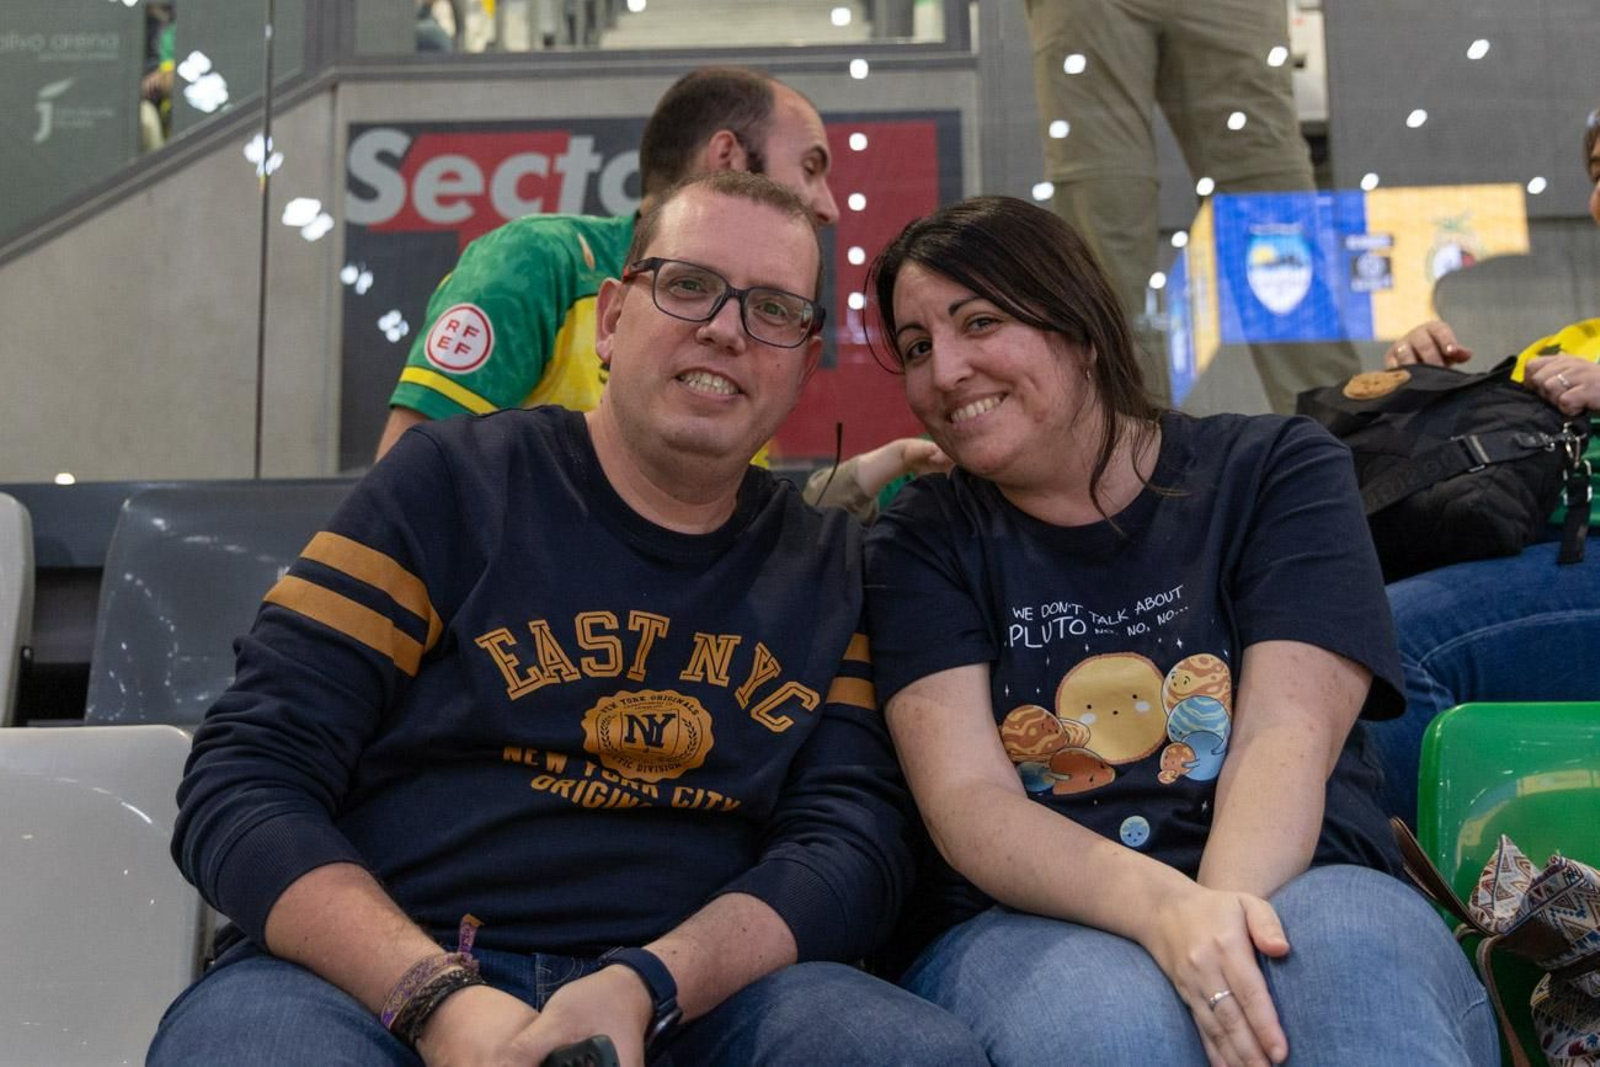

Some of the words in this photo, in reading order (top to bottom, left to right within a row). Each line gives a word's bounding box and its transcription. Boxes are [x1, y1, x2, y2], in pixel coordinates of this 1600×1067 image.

[344, 127, 641, 227] Secto
[1012, 607, 1033, 621] WE
[1041, 601, 1083, 619] DON'T
[1088, 608, 1129, 626] TALK
[1134, 584, 1184, 616] ABOUT
[1009, 616, 1087, 648] PLUTO
[474, 610, 670, 701] EAST
[679, 632, 821, 734] NYC
[624, 713, 677, 749] NY
[636, 762, 682, 774] DIVISION
[530, 774, 653, 809] ORIGIN
[671, 786, 742, 812] CITY
